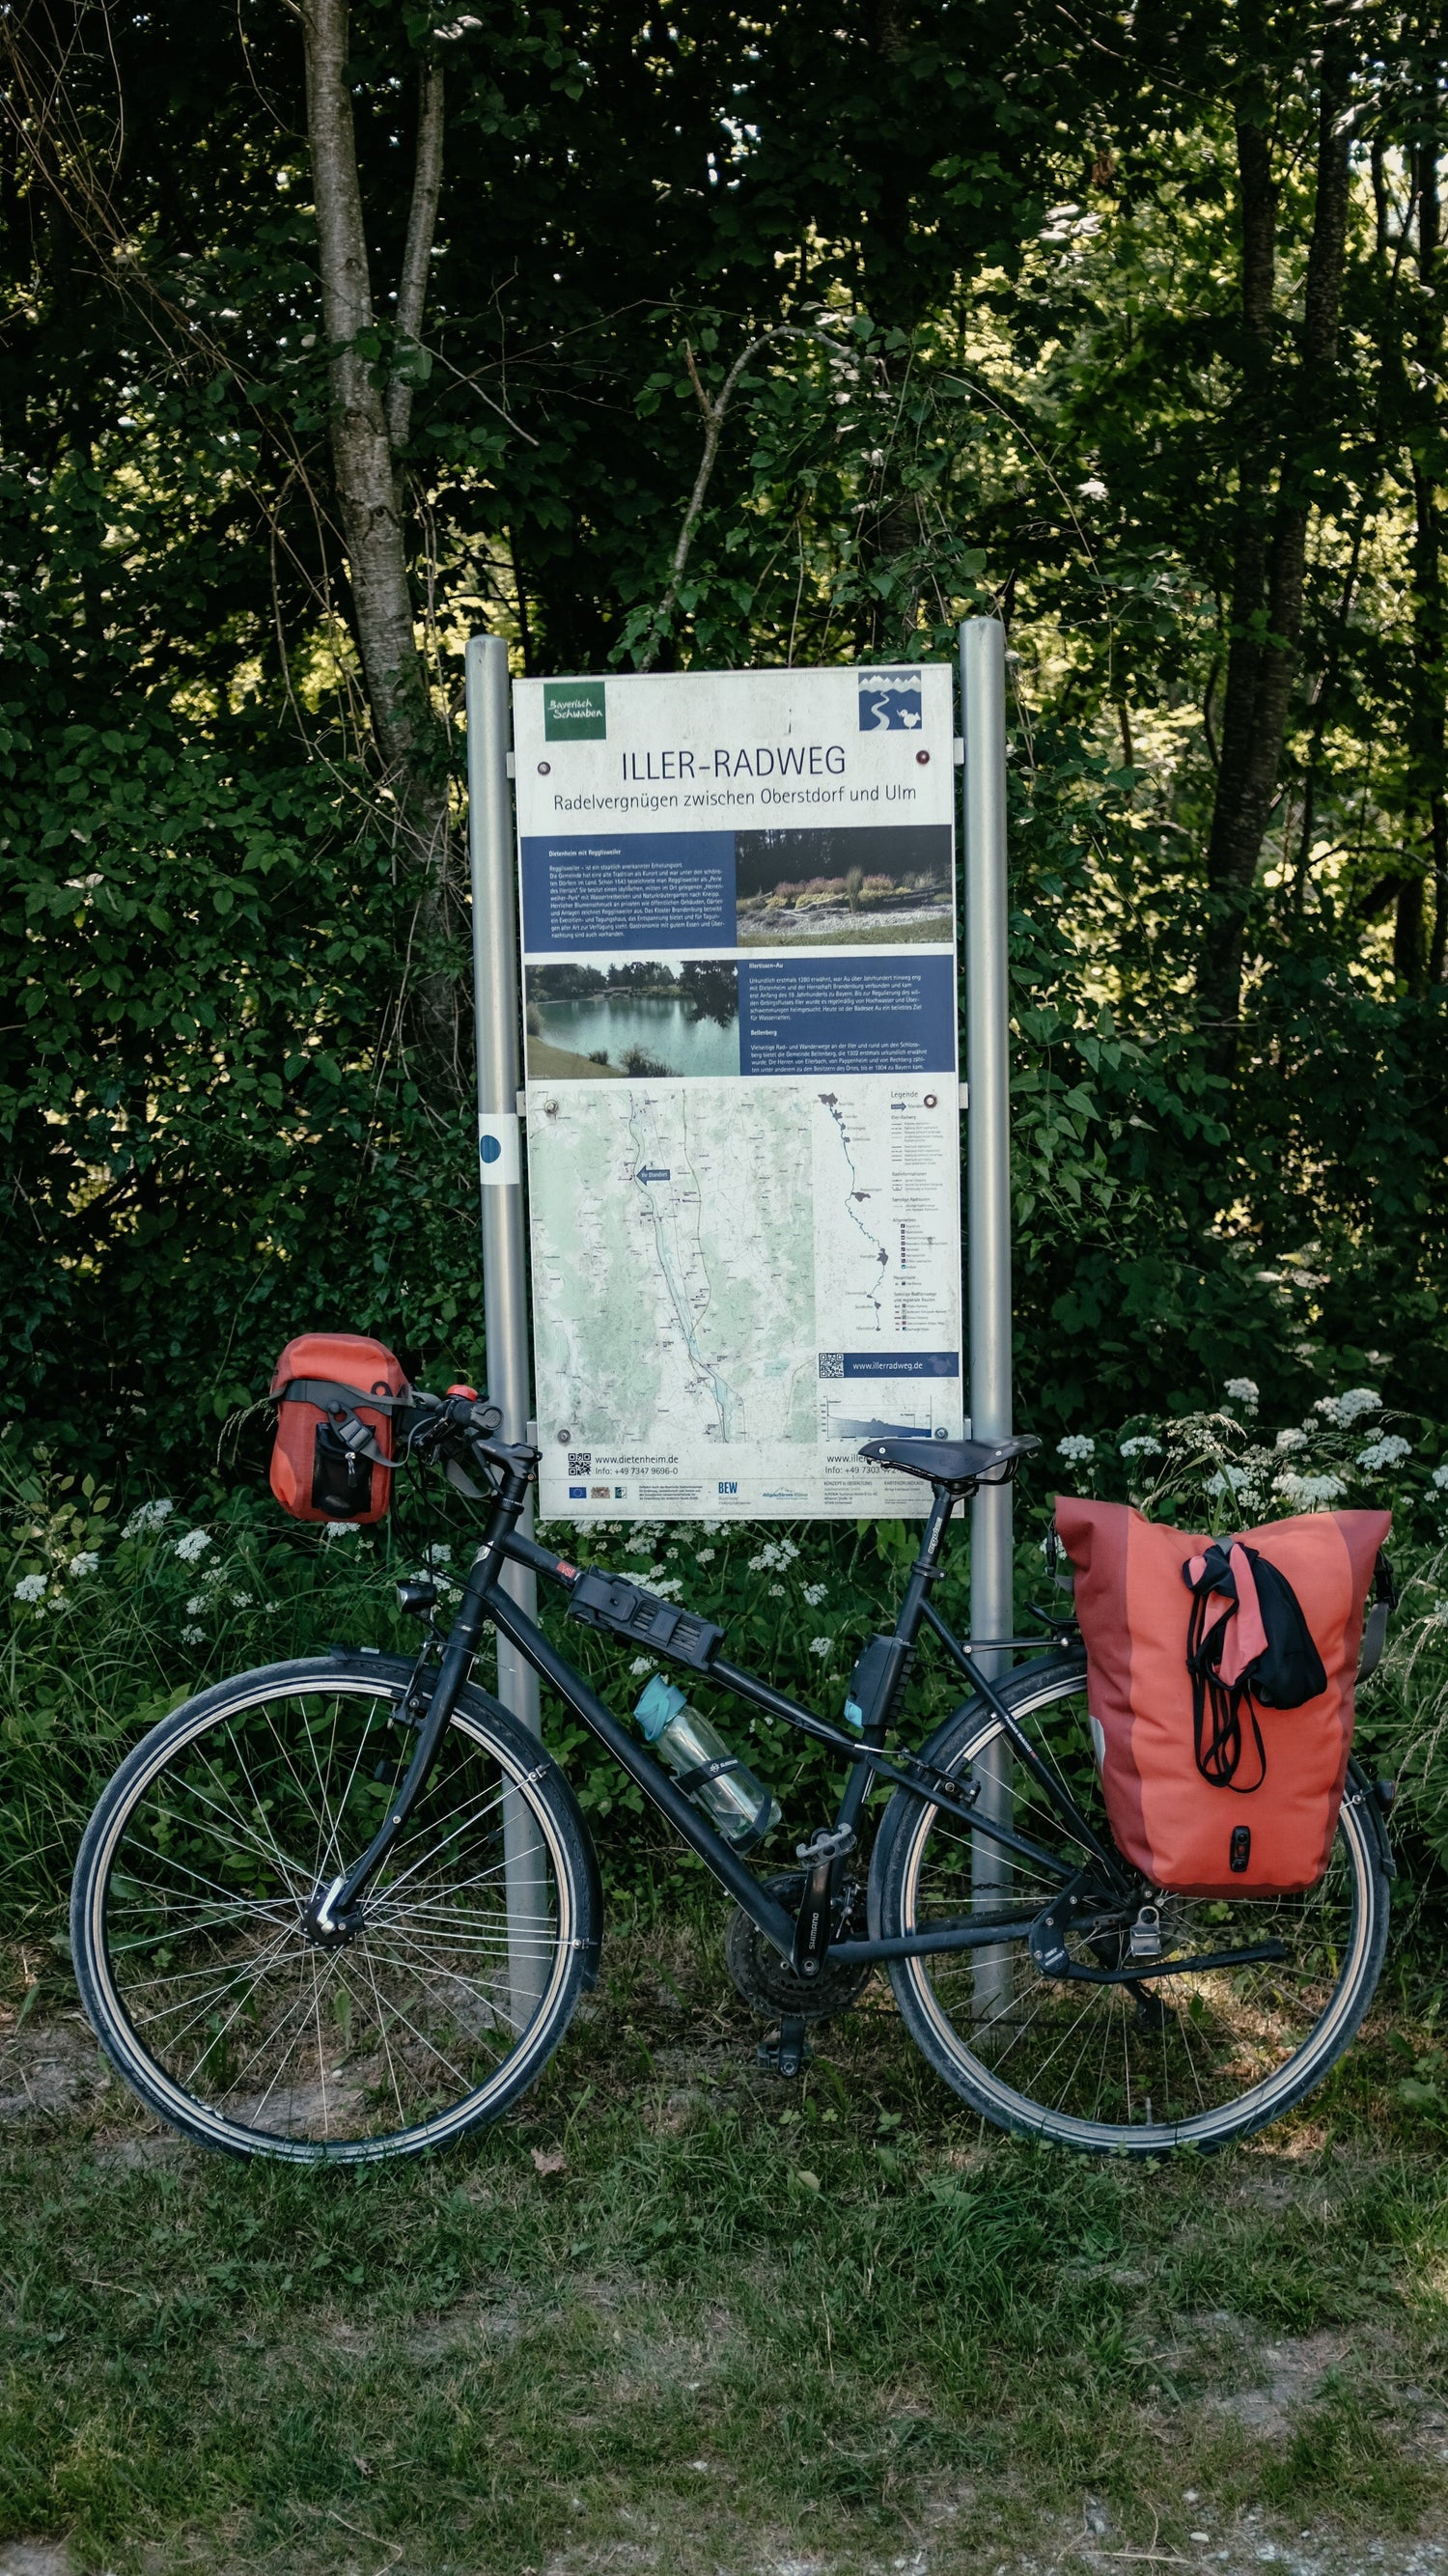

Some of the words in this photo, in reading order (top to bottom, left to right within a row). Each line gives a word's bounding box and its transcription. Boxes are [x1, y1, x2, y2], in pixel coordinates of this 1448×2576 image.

[548, 699, 592, 710] Bayerisch
[553, 708, 603, 719] Schwaben
[623, 745, 845, 780] ILLER-RADWEG
[554, 793, 677, 812] Radelvergnügen
[684, 791, 754, 806] zwischen
[761, 786, 845, 804] Oberstdorf
[850, 785, 879, 802] und
[886, 784, 916, 800] Ulm
[853, 1361, 923, 1371] www.illerradweg.de
[595, 1455, 678, 1463] www.dietenheim.de
[718, 1482, 737, 1493] BEW
[809, 1912, 819, 1950] SHIMANO
